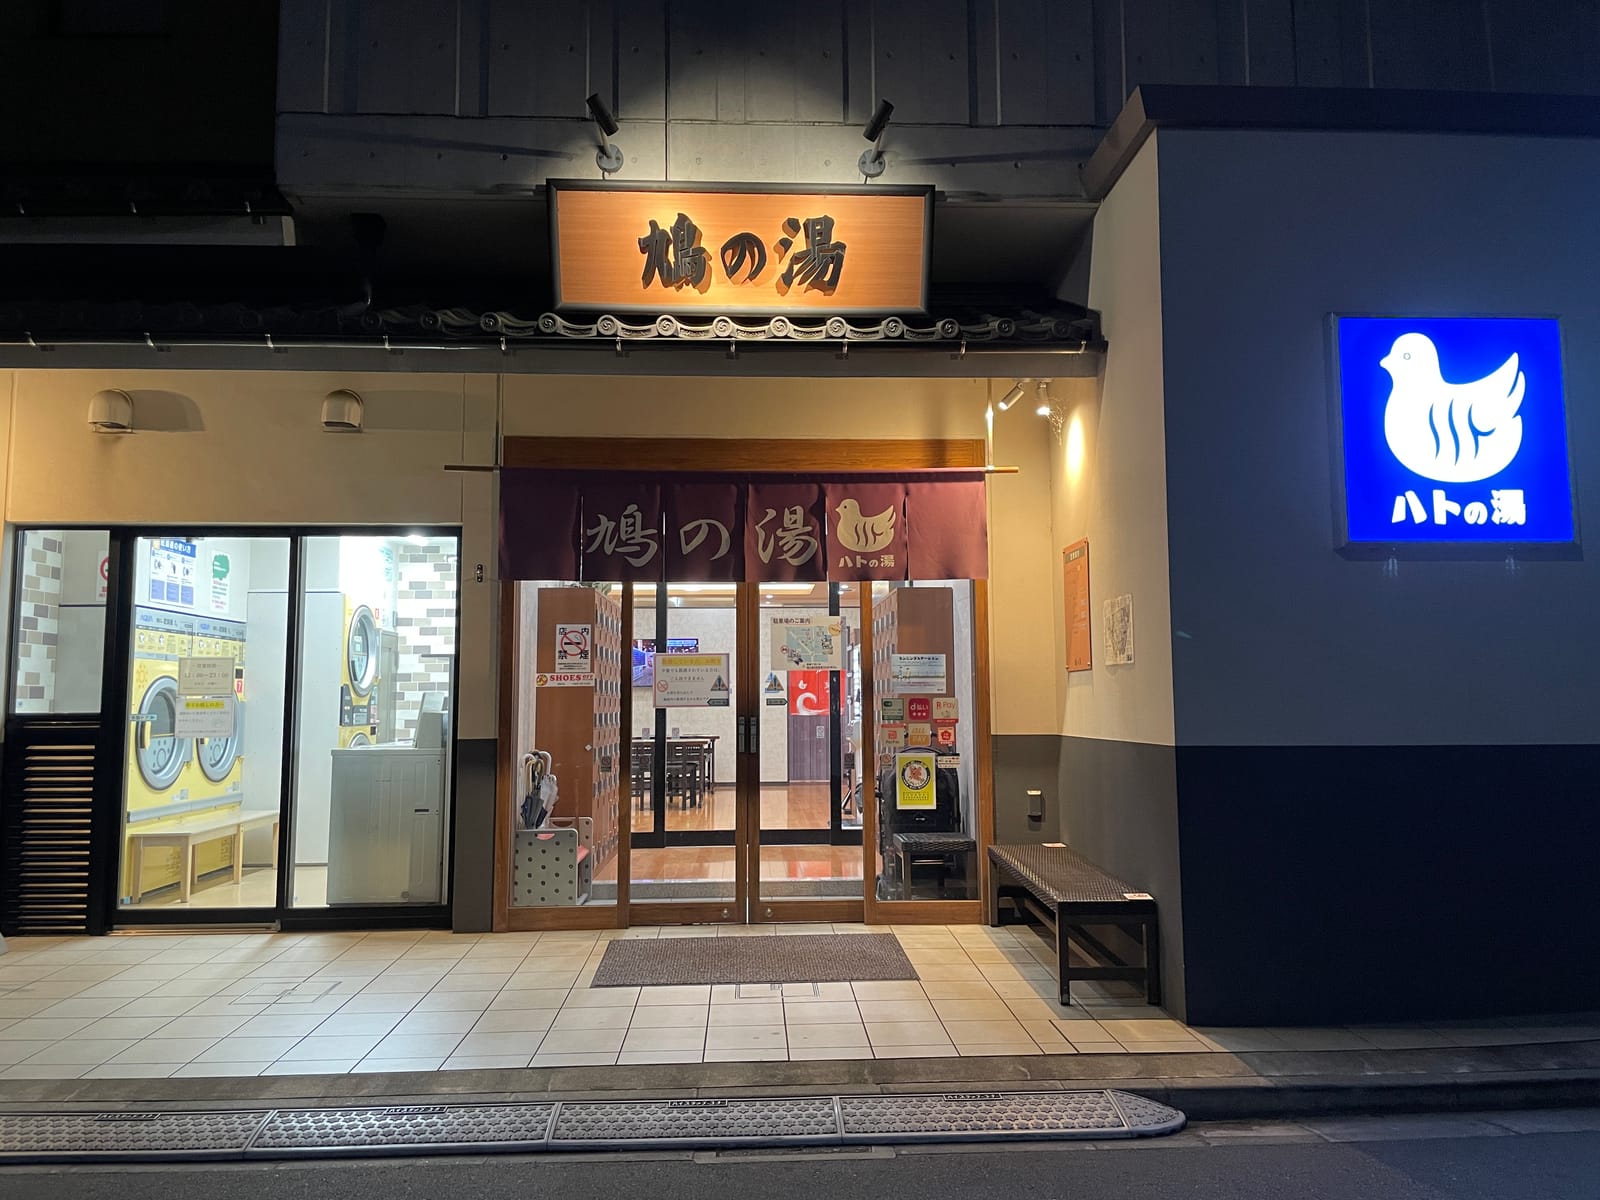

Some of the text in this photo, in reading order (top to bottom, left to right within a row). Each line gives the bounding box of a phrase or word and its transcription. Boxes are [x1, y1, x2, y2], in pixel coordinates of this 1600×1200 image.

[638, 212, 848, 297] 鳩の湯
[1391, 489, 1527, 525] ハトの湯
[586, 503, 818, 567] 鳩の湯
[838, 554, 895, 568] ハトの湯
[772, 617, 811, 625] 駐車場のご案内
[550, 674, 582, 682] SHOES
[910, 702, 929, 710] d払い
[943, 702, 956, 710] Pay
